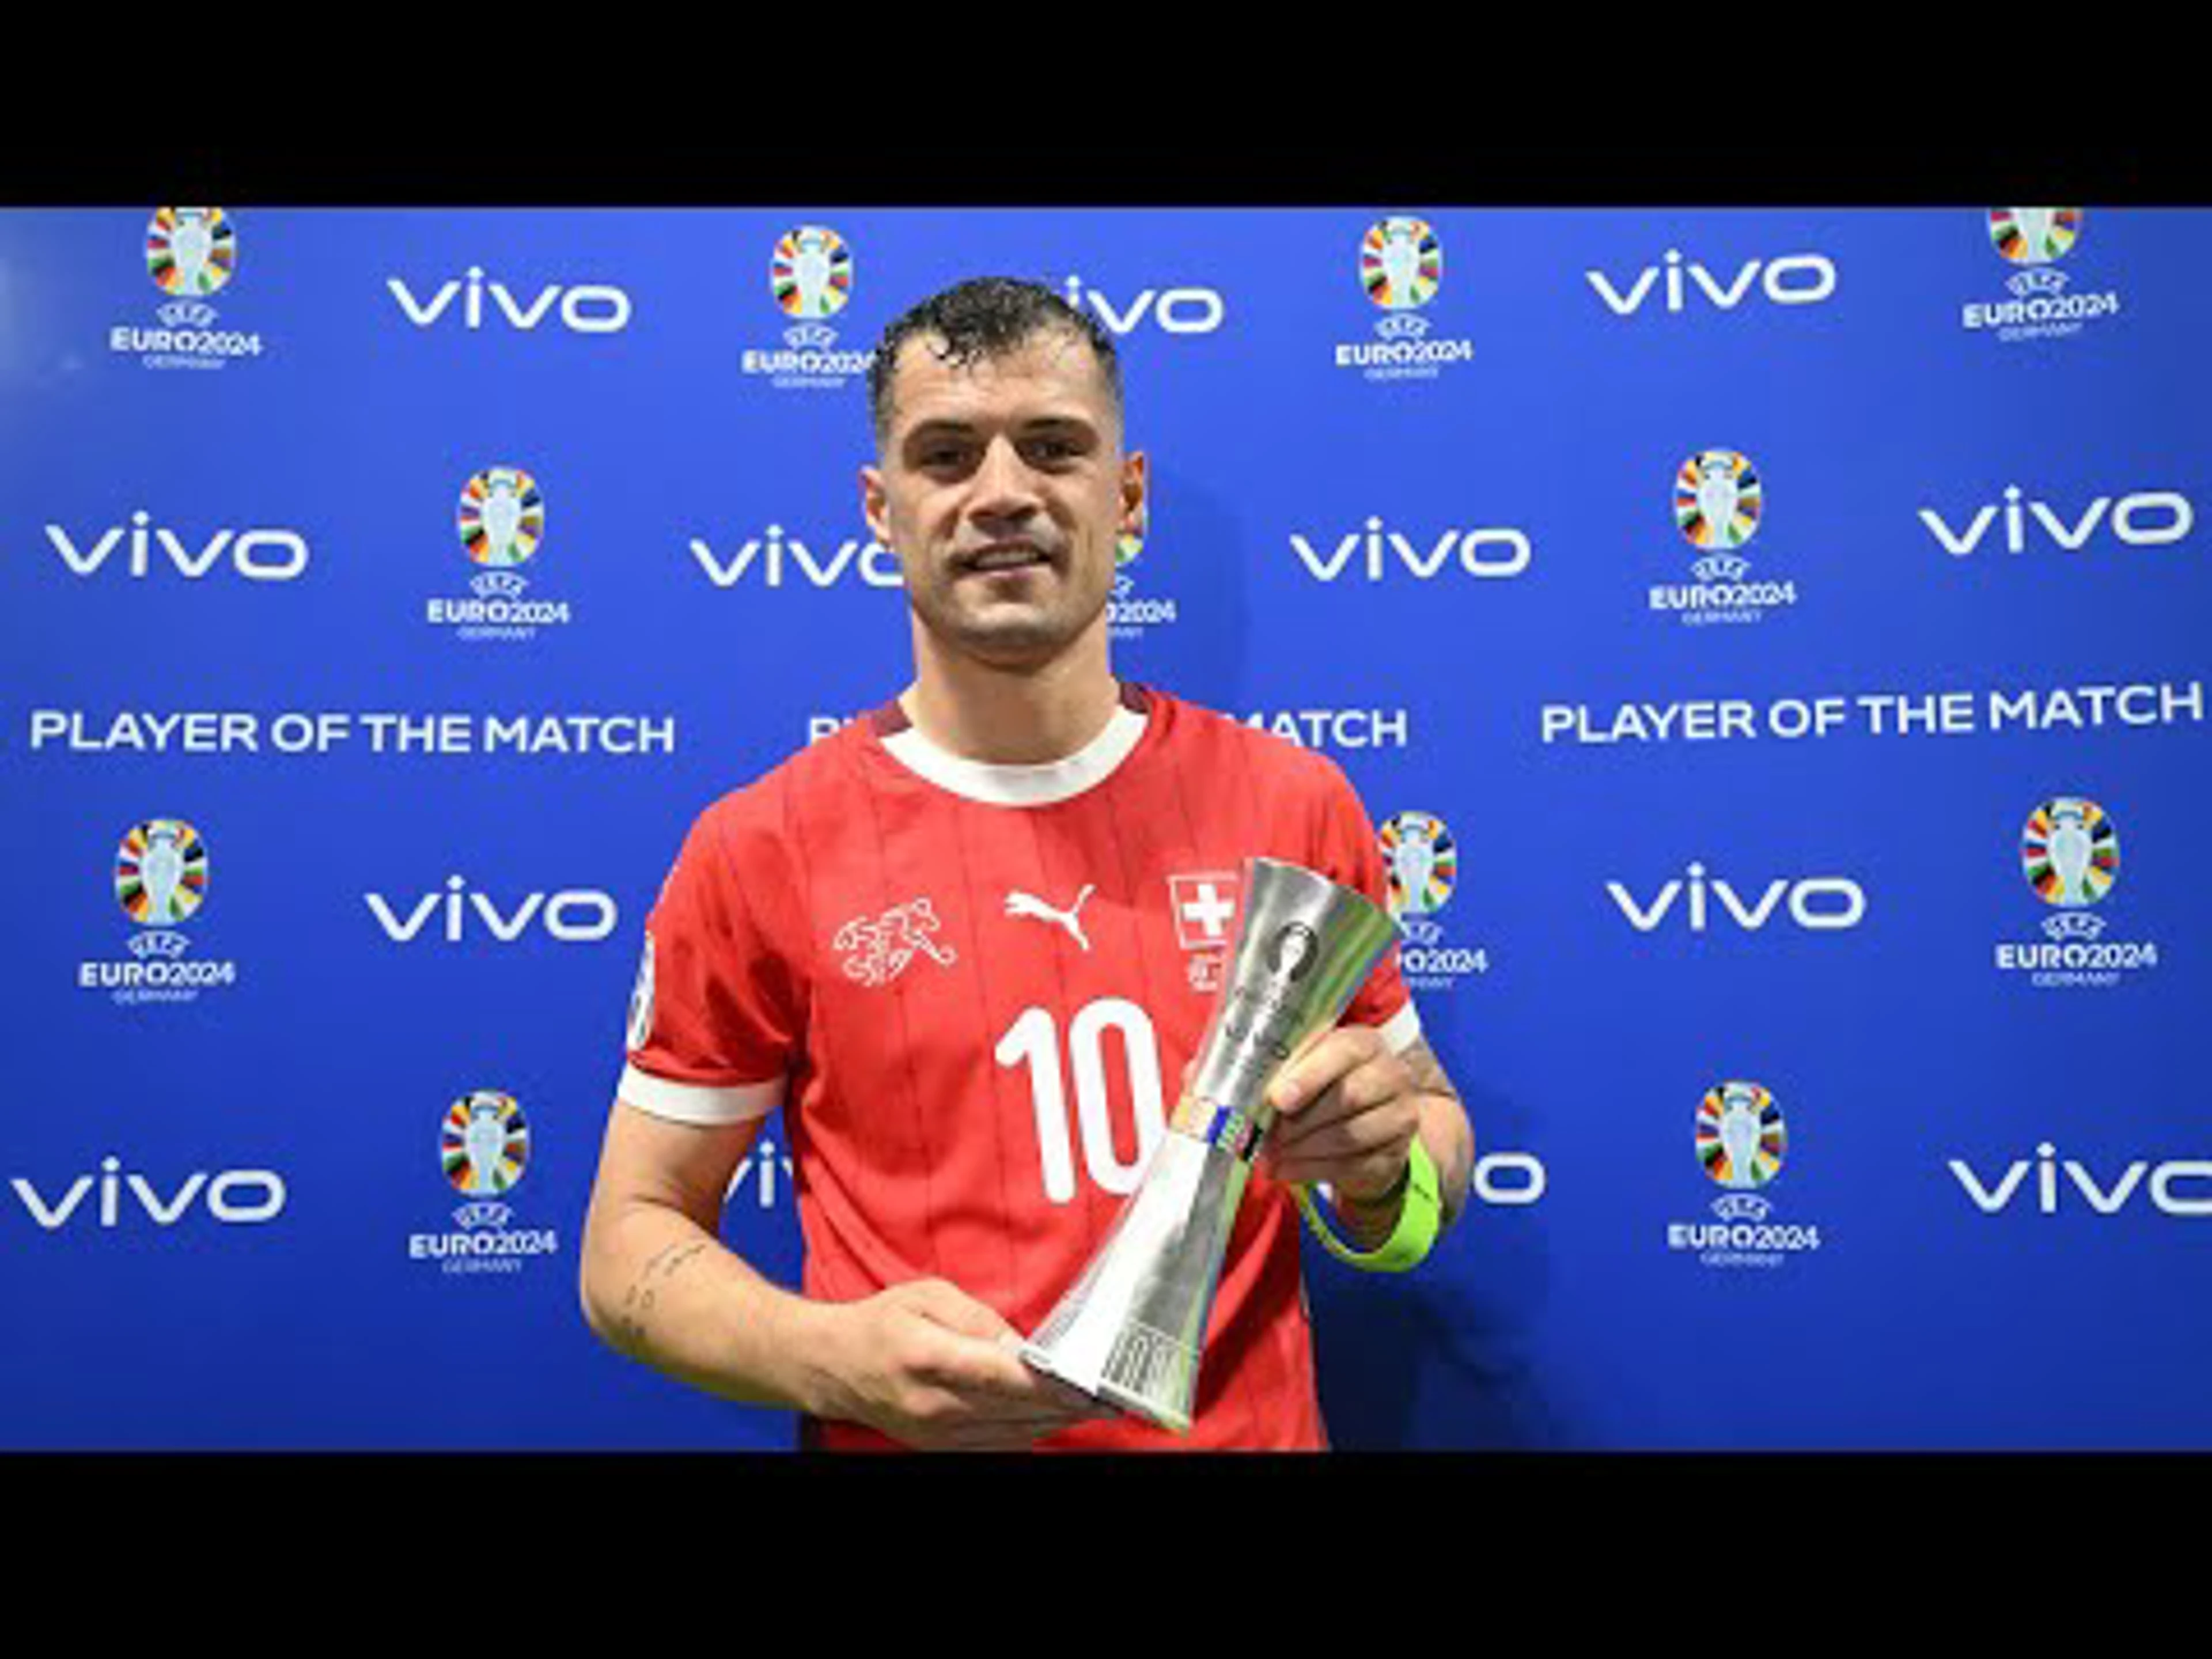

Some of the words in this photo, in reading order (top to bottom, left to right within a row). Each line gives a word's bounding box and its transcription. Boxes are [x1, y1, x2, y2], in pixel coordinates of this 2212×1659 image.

[388, 267, 630, 332] vivo
[1064, 275, 1223, 333] ivo
[1587, 249, 1836, 315] vivo
[1963, 291, 2118, 327] EURO2024
[111, 327, 261, 356] EURO2024
[1336, 339, 1474, 366] EURO2024
[46, 511, 309, 579] vivo
[1919, 486, 2193, 556] vivo
[1290, 516, 1531, 581] vivo
[427, 599, 570, 623] EURO2024
[1106, 600, 1177, 623] 2024
[1649, 582, 1797, 609] EURO2024
[31, 711, 259, 751] PLAYER
[271, 714, 349, 752] OF
[360, 715, 471, 752] THE
[484, 717, 674, 753] MATCH
[1541, 700, 1756, 743] PLAYER
[1769, 698, 1845, 737] OF
[1858, 694, 1974, 734] THE
[1990, 682, 2203, 729] MATCH
[365, 875, 618, 942] vivo
[1607, 862, 1866, 931] vivo
[78, 963, 236, 986] EURO2024
[1395, 949, 1488, 974] O2024
[1995, 942, 2157, 968] EURO2024
[995, 999, 1168, 1202] 10
[12, 1157, 286, 1228] vivo
[1948, 1142, 2212, 1214] vivo
[409, 1231, 558, 1259] EURO2024
[1667, 1224, 1820, 1250] EURO2024
